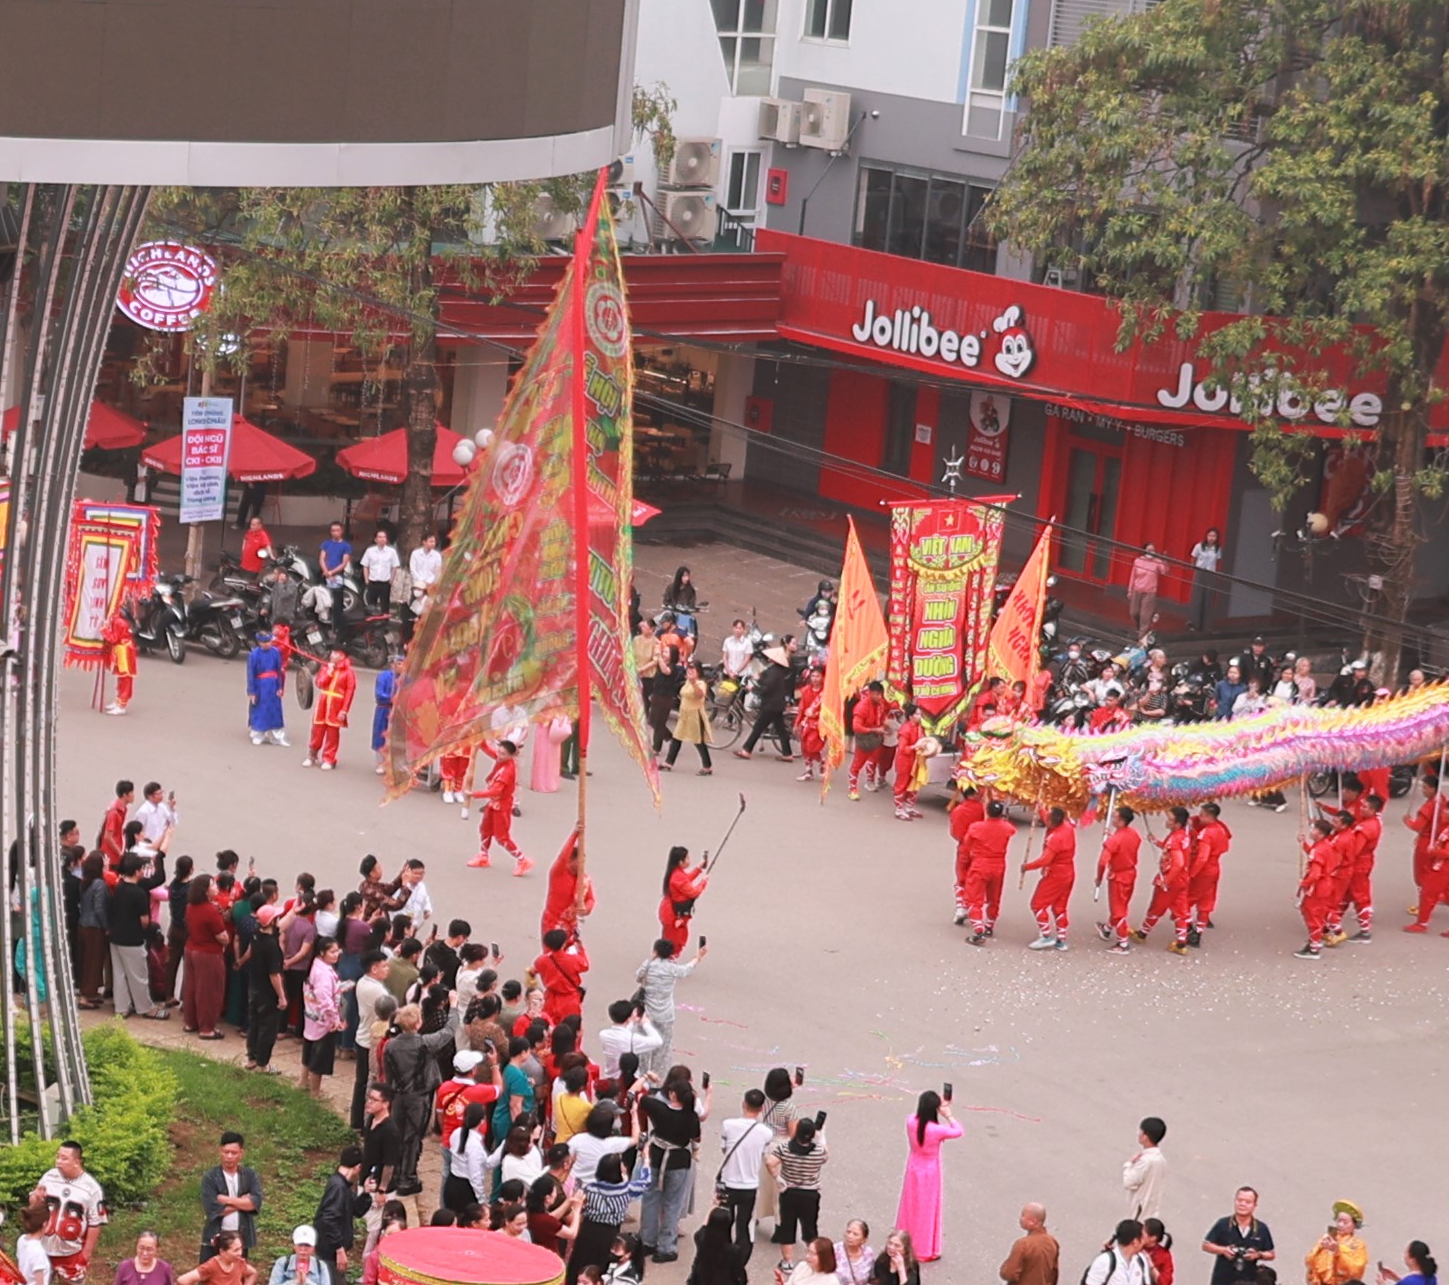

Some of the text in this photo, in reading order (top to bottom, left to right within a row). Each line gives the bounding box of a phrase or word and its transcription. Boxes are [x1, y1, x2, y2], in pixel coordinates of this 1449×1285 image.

[128, 300, 201, 327] COFFEE
[852, 298, 981, 367] Jollibee
[1156, 361, 1384, 428] Jollibee
[187, 434, 204, 445] ĐỘI
[1133, 423, 1186, 447] BURGERS
[191, 445, 209, 455] BÁC
[239, 471, 285, 482] HIGHLANDS
[921, 533, 947, 557] VIỆT
